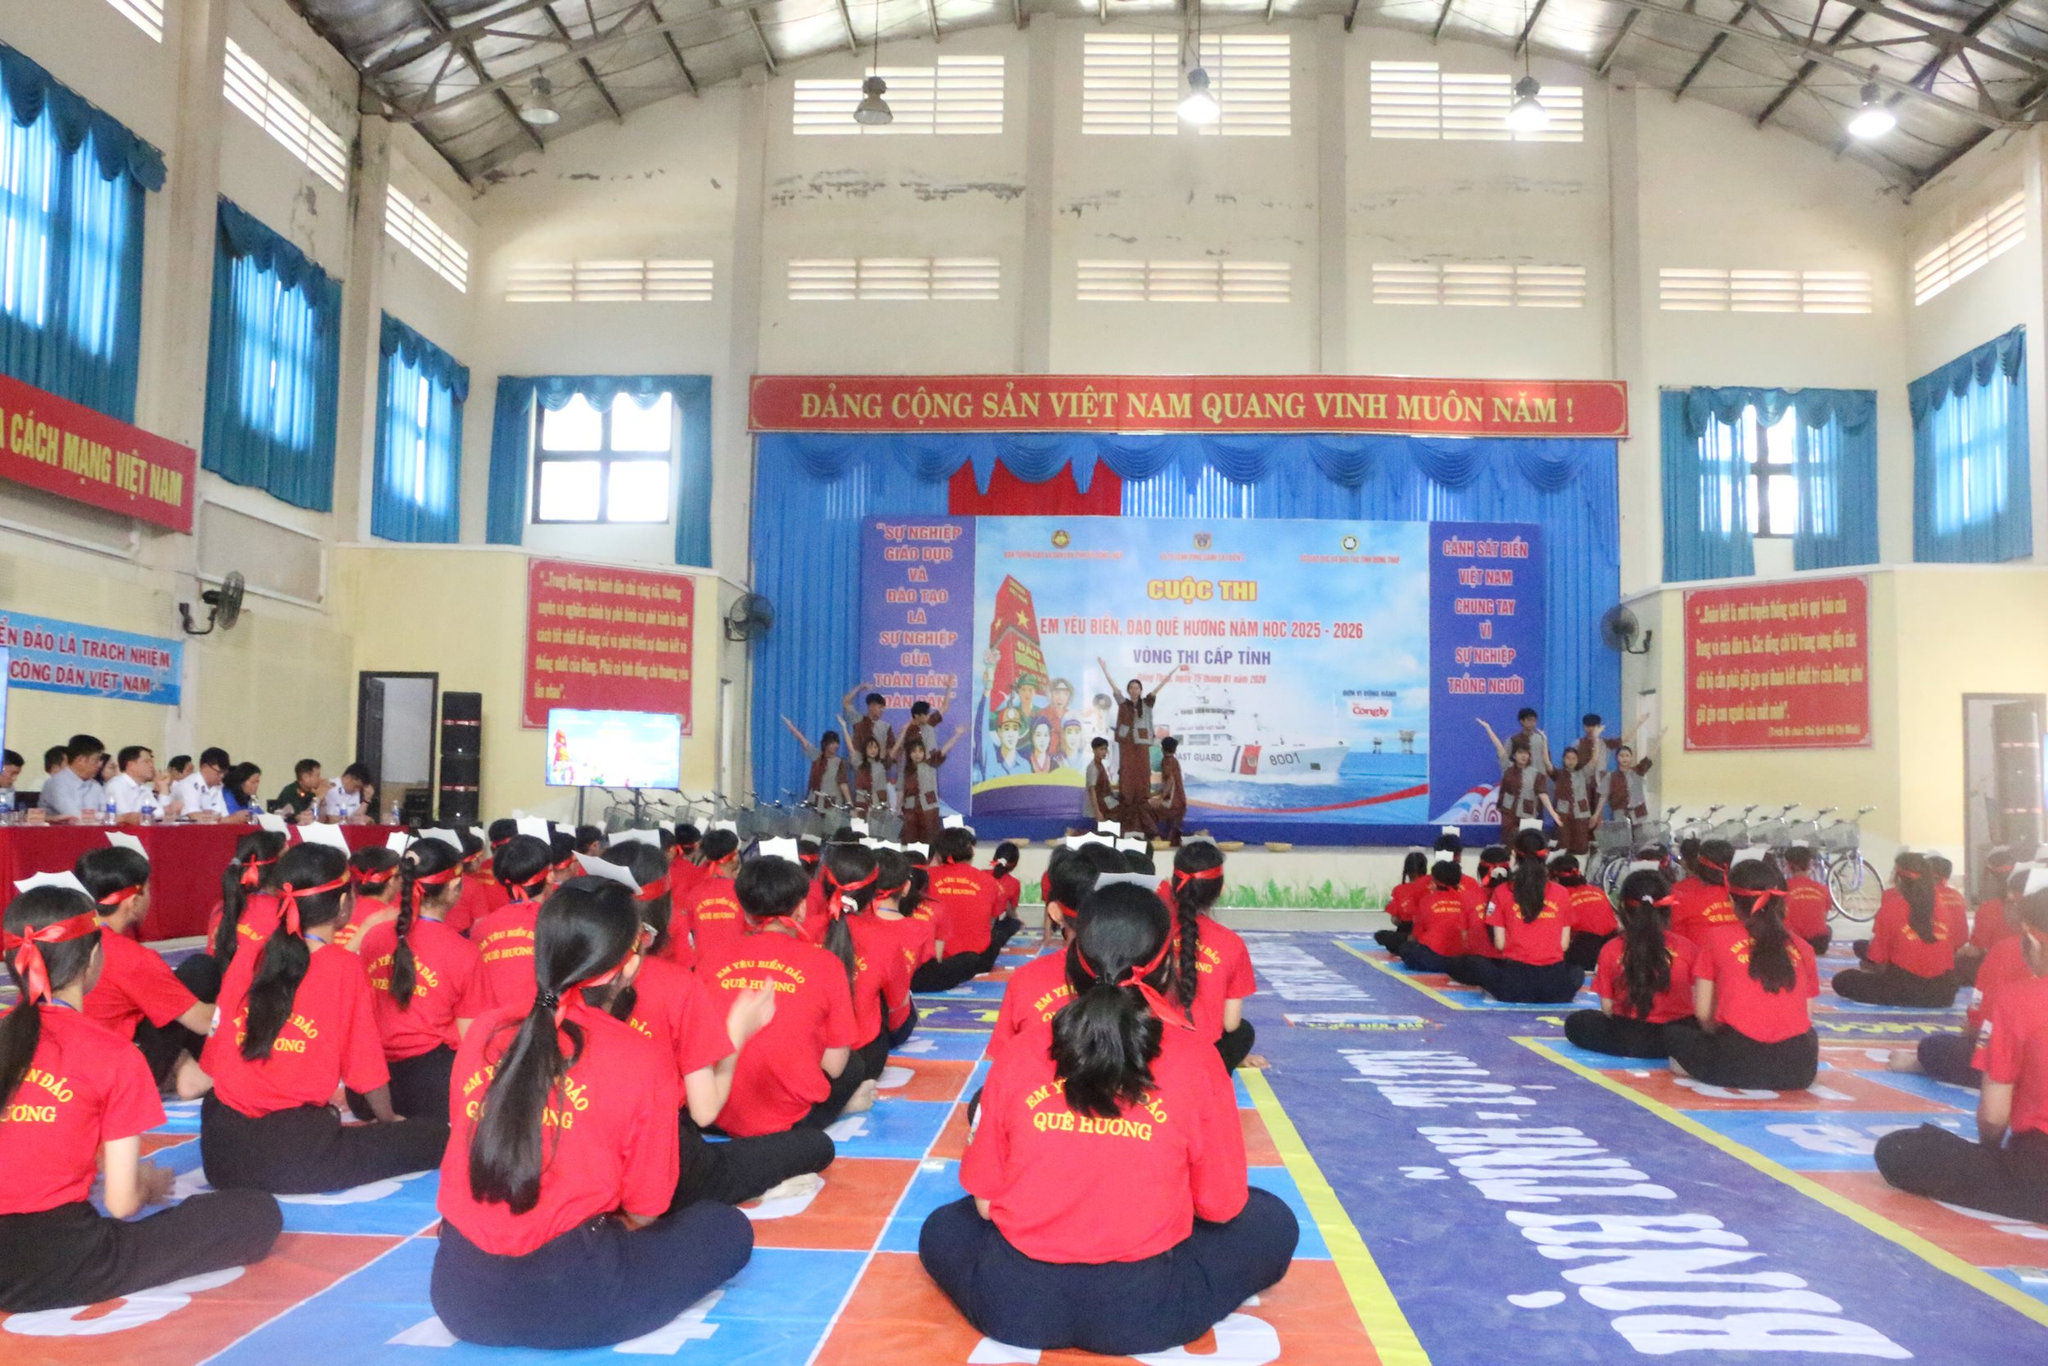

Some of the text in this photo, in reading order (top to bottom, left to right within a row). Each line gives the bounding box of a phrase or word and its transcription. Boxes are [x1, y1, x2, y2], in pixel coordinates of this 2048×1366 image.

[801, 382, 1574, 425] ĐẢNG CỘNG SẢN VIỆT NAM QUANG VINH MUÔN NĂM !
[10, 409, 183, 507] CÁCH MẠNG VIỆT NAM
[908, 525, 962, 543] NGHIỆP
[1458, 566, 1513, 588] VIỆT NAM
[1147, 576, 1258, 604] CUỘC THI
[1455, 598, 1515, 615] CHUNG TAY
[904, 631, 958, 647] NGHIỆP
[1040, 618, 1059, 634] EM
[1064, 616, 1086, 634] YÊU
[1156, 617, 1179, 637] QUÊ
[1263, 621, 1287, 640] HỌC
[1291, 622, 1321, 638] 2025
[1333, 623, 1363, 639] 2026
[1133, 646, 1172, 664] VÒNG
[1177, 649, 1199, 664] THI
[1204, 645, 1233, 665] CẤP
[1474, 645, 1516, 667] NGHIỆP
[10, 658, 51, 682] CÔNG
[56, 664, 84, 686] DÂN
[123, 675, 150, 693] NAM
[874, 671, 913, 688] TOÀN
[1194, 753, 1222, 762] GUARD
[1269, 752, 1301, 766] 8001
[1337, 1049, 1491, 1076] TIN
[39, 1072, 73, 1102] ĐẢO
[1026, 1085, 1050, 1109] EM
[1033, 1109, 1152, 1141] QUÊ HƯƠNG
[1505, 1210, 1915, 1359] BÌNH
